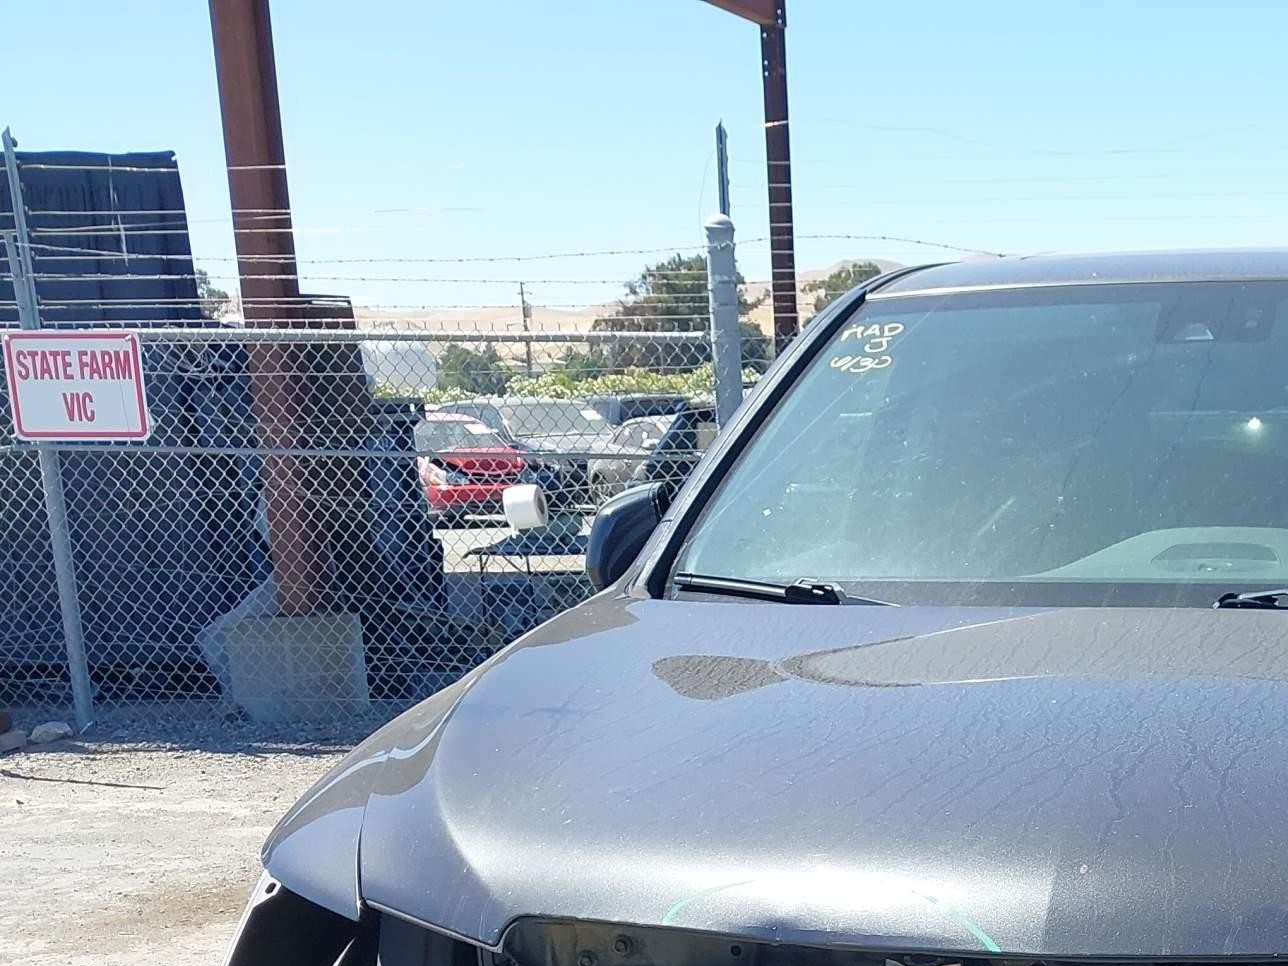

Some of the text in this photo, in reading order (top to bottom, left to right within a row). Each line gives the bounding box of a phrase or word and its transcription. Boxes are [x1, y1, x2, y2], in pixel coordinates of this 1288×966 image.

[15, 350, 133, 381] STATE FARM
[62, 392, 96, 422] VIC
